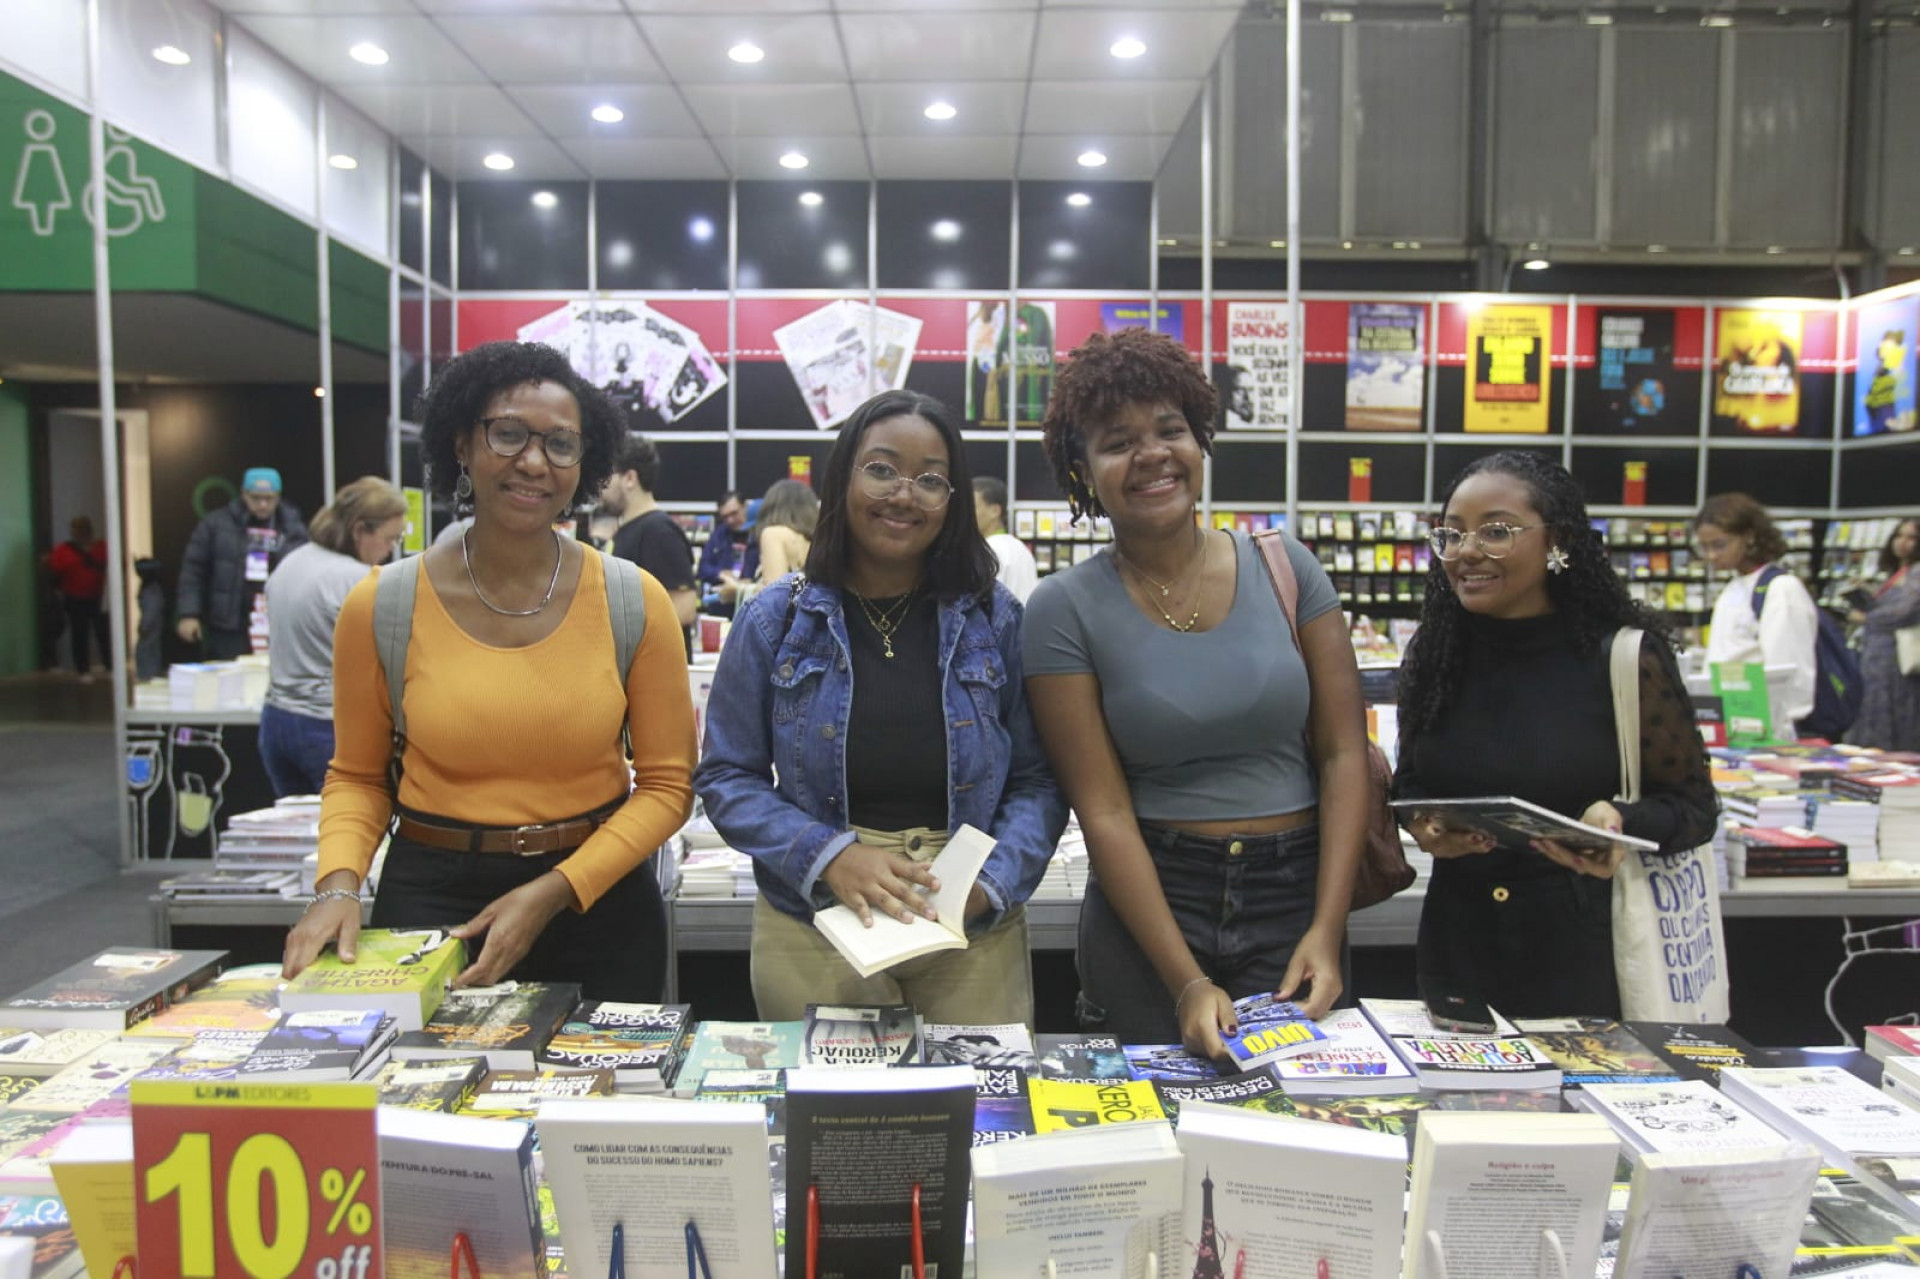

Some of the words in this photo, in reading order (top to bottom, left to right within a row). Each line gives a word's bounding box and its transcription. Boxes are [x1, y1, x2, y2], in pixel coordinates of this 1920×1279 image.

[1242, 1023, 1315, 1055] UIVO
[547, 1050, 661, 1064] KEROUAC
[812, 1045, 902, 1058] KEROUAC
[1419, 1051, 1537, 1065] AQUARELA
[146, 1132, 311, 1279] 10
[319, 1168, 373, 1236] %
[316, 1244, 372, 1279] off
